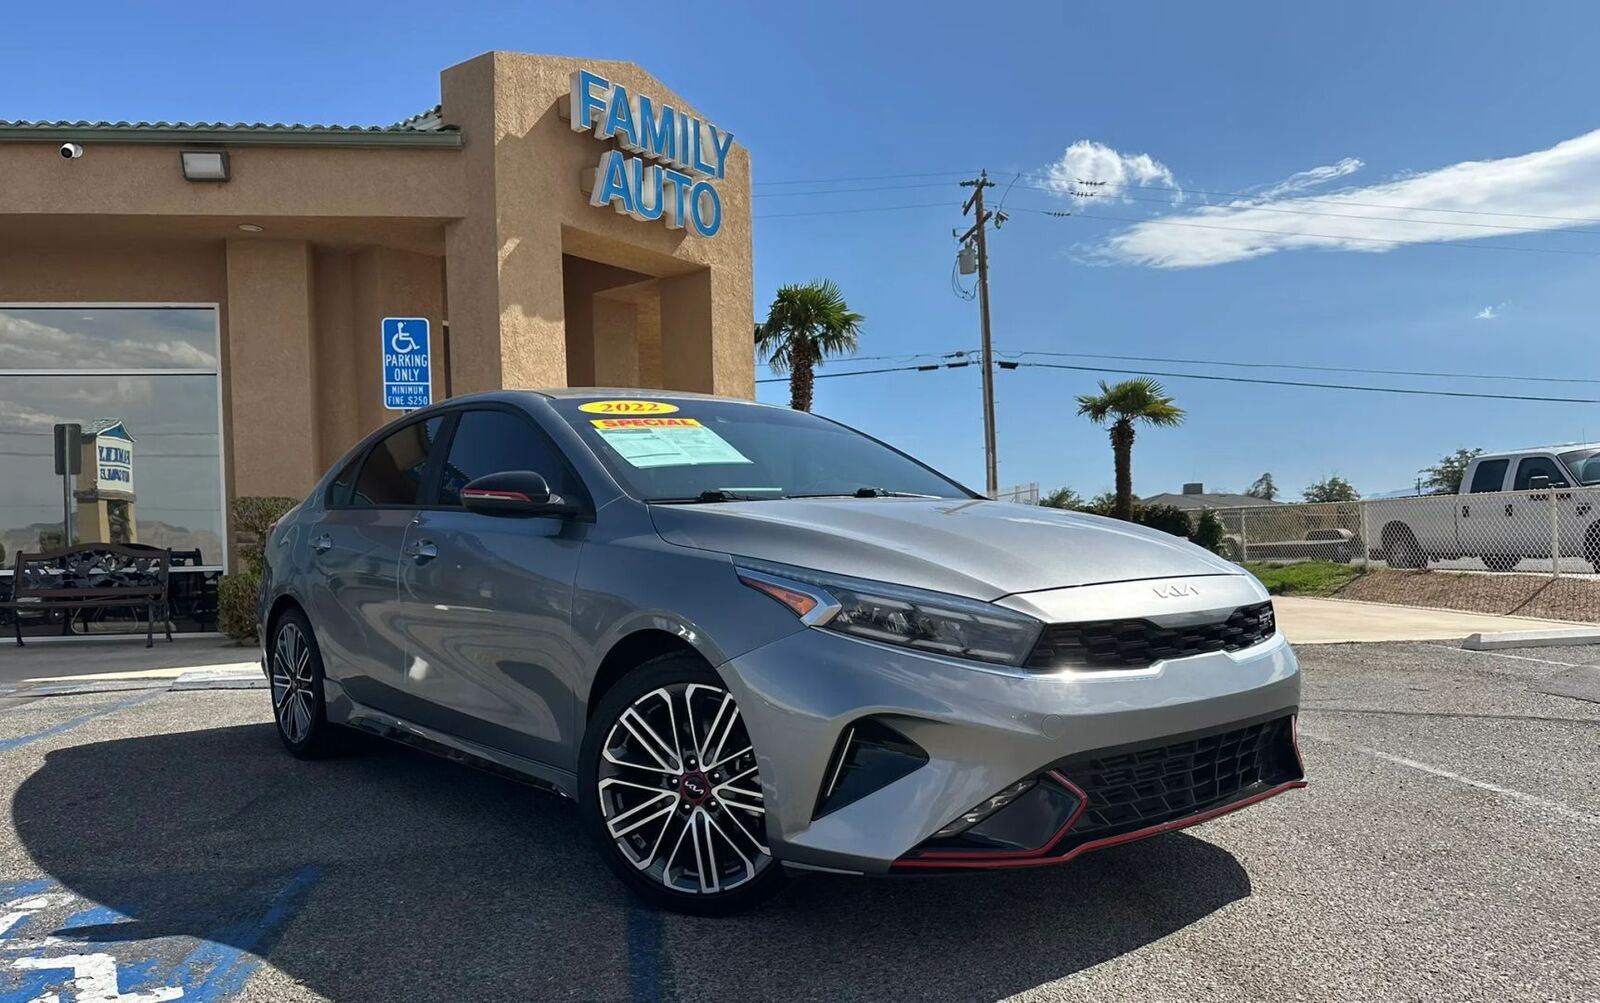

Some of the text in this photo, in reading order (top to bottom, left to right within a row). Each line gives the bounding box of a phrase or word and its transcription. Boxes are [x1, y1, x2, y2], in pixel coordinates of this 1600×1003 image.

[571, 69, 734, 180] FAMILY
[592, 150, 722, 237] AUTO
[385, 354, 428, 368] PARKING
[394, 368, 420, 382] ONLY
[391, 385, 424, 395] MINIMUM
[387, 395, 428, 405] FINE $250
[599, 402, 660, 412] 2022
[602, 418, 694, 428] SPECIAL
